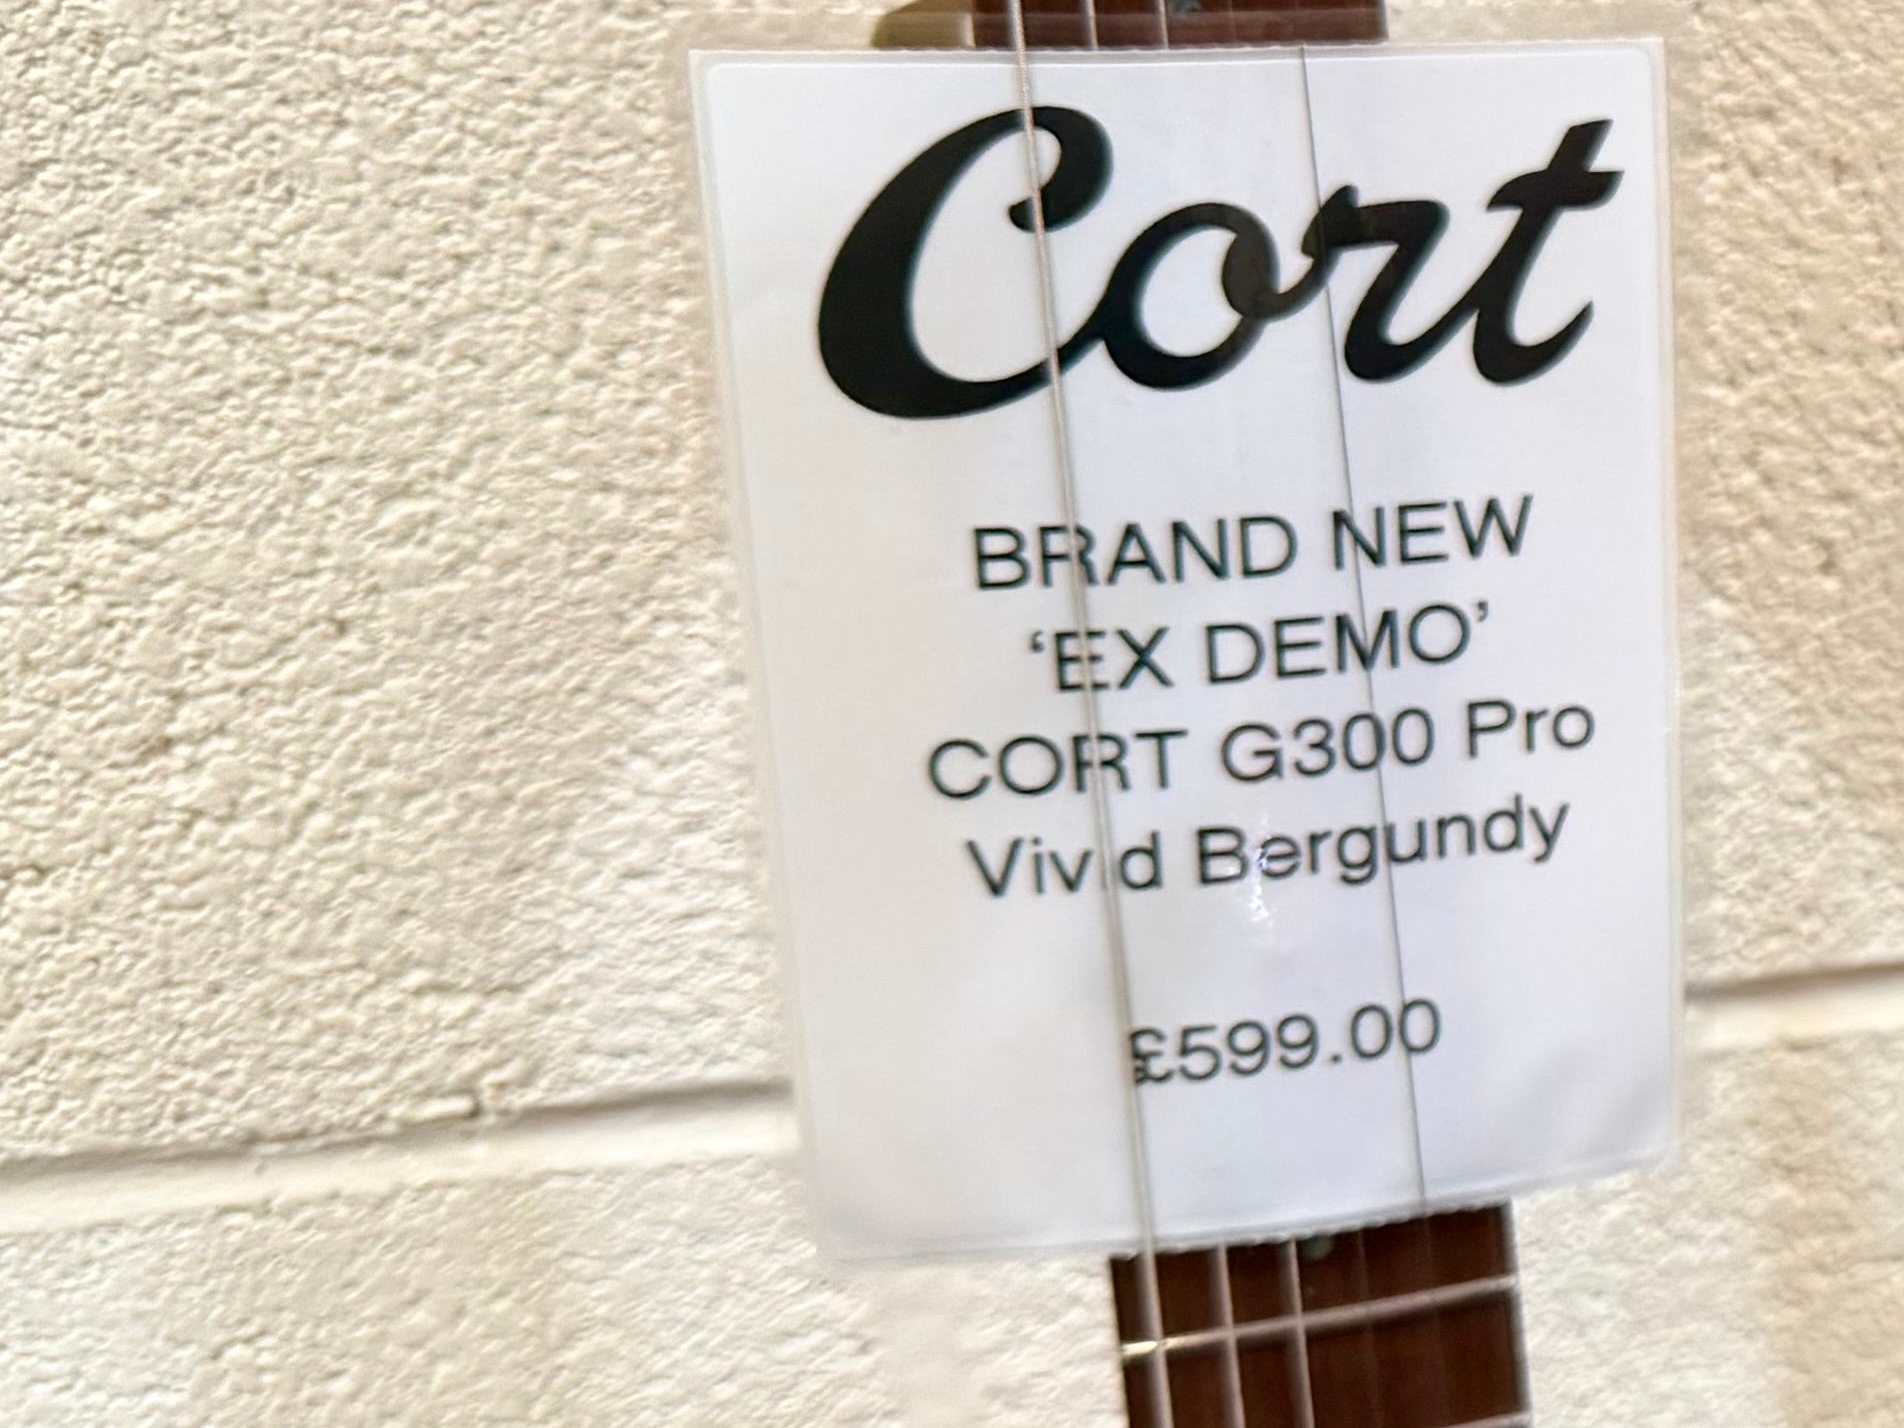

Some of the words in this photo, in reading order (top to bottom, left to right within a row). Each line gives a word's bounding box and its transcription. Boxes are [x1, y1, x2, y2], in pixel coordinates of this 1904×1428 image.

[815, 104, 1623, 421] Cort
[972, 515, 1298, 591] BRAND
[1331, 494, 1532, 571] NEW
[928, 729, 1189, 801] CORT
[1220, 707, 1435, 784] G300
[1466, 699, 1594, 758] Pro
[966, 831, 1162, 898] Vivd
[1195, 794, 1568, 888] Bergundy
[1128, 998, 1441, 1087] £599.00
